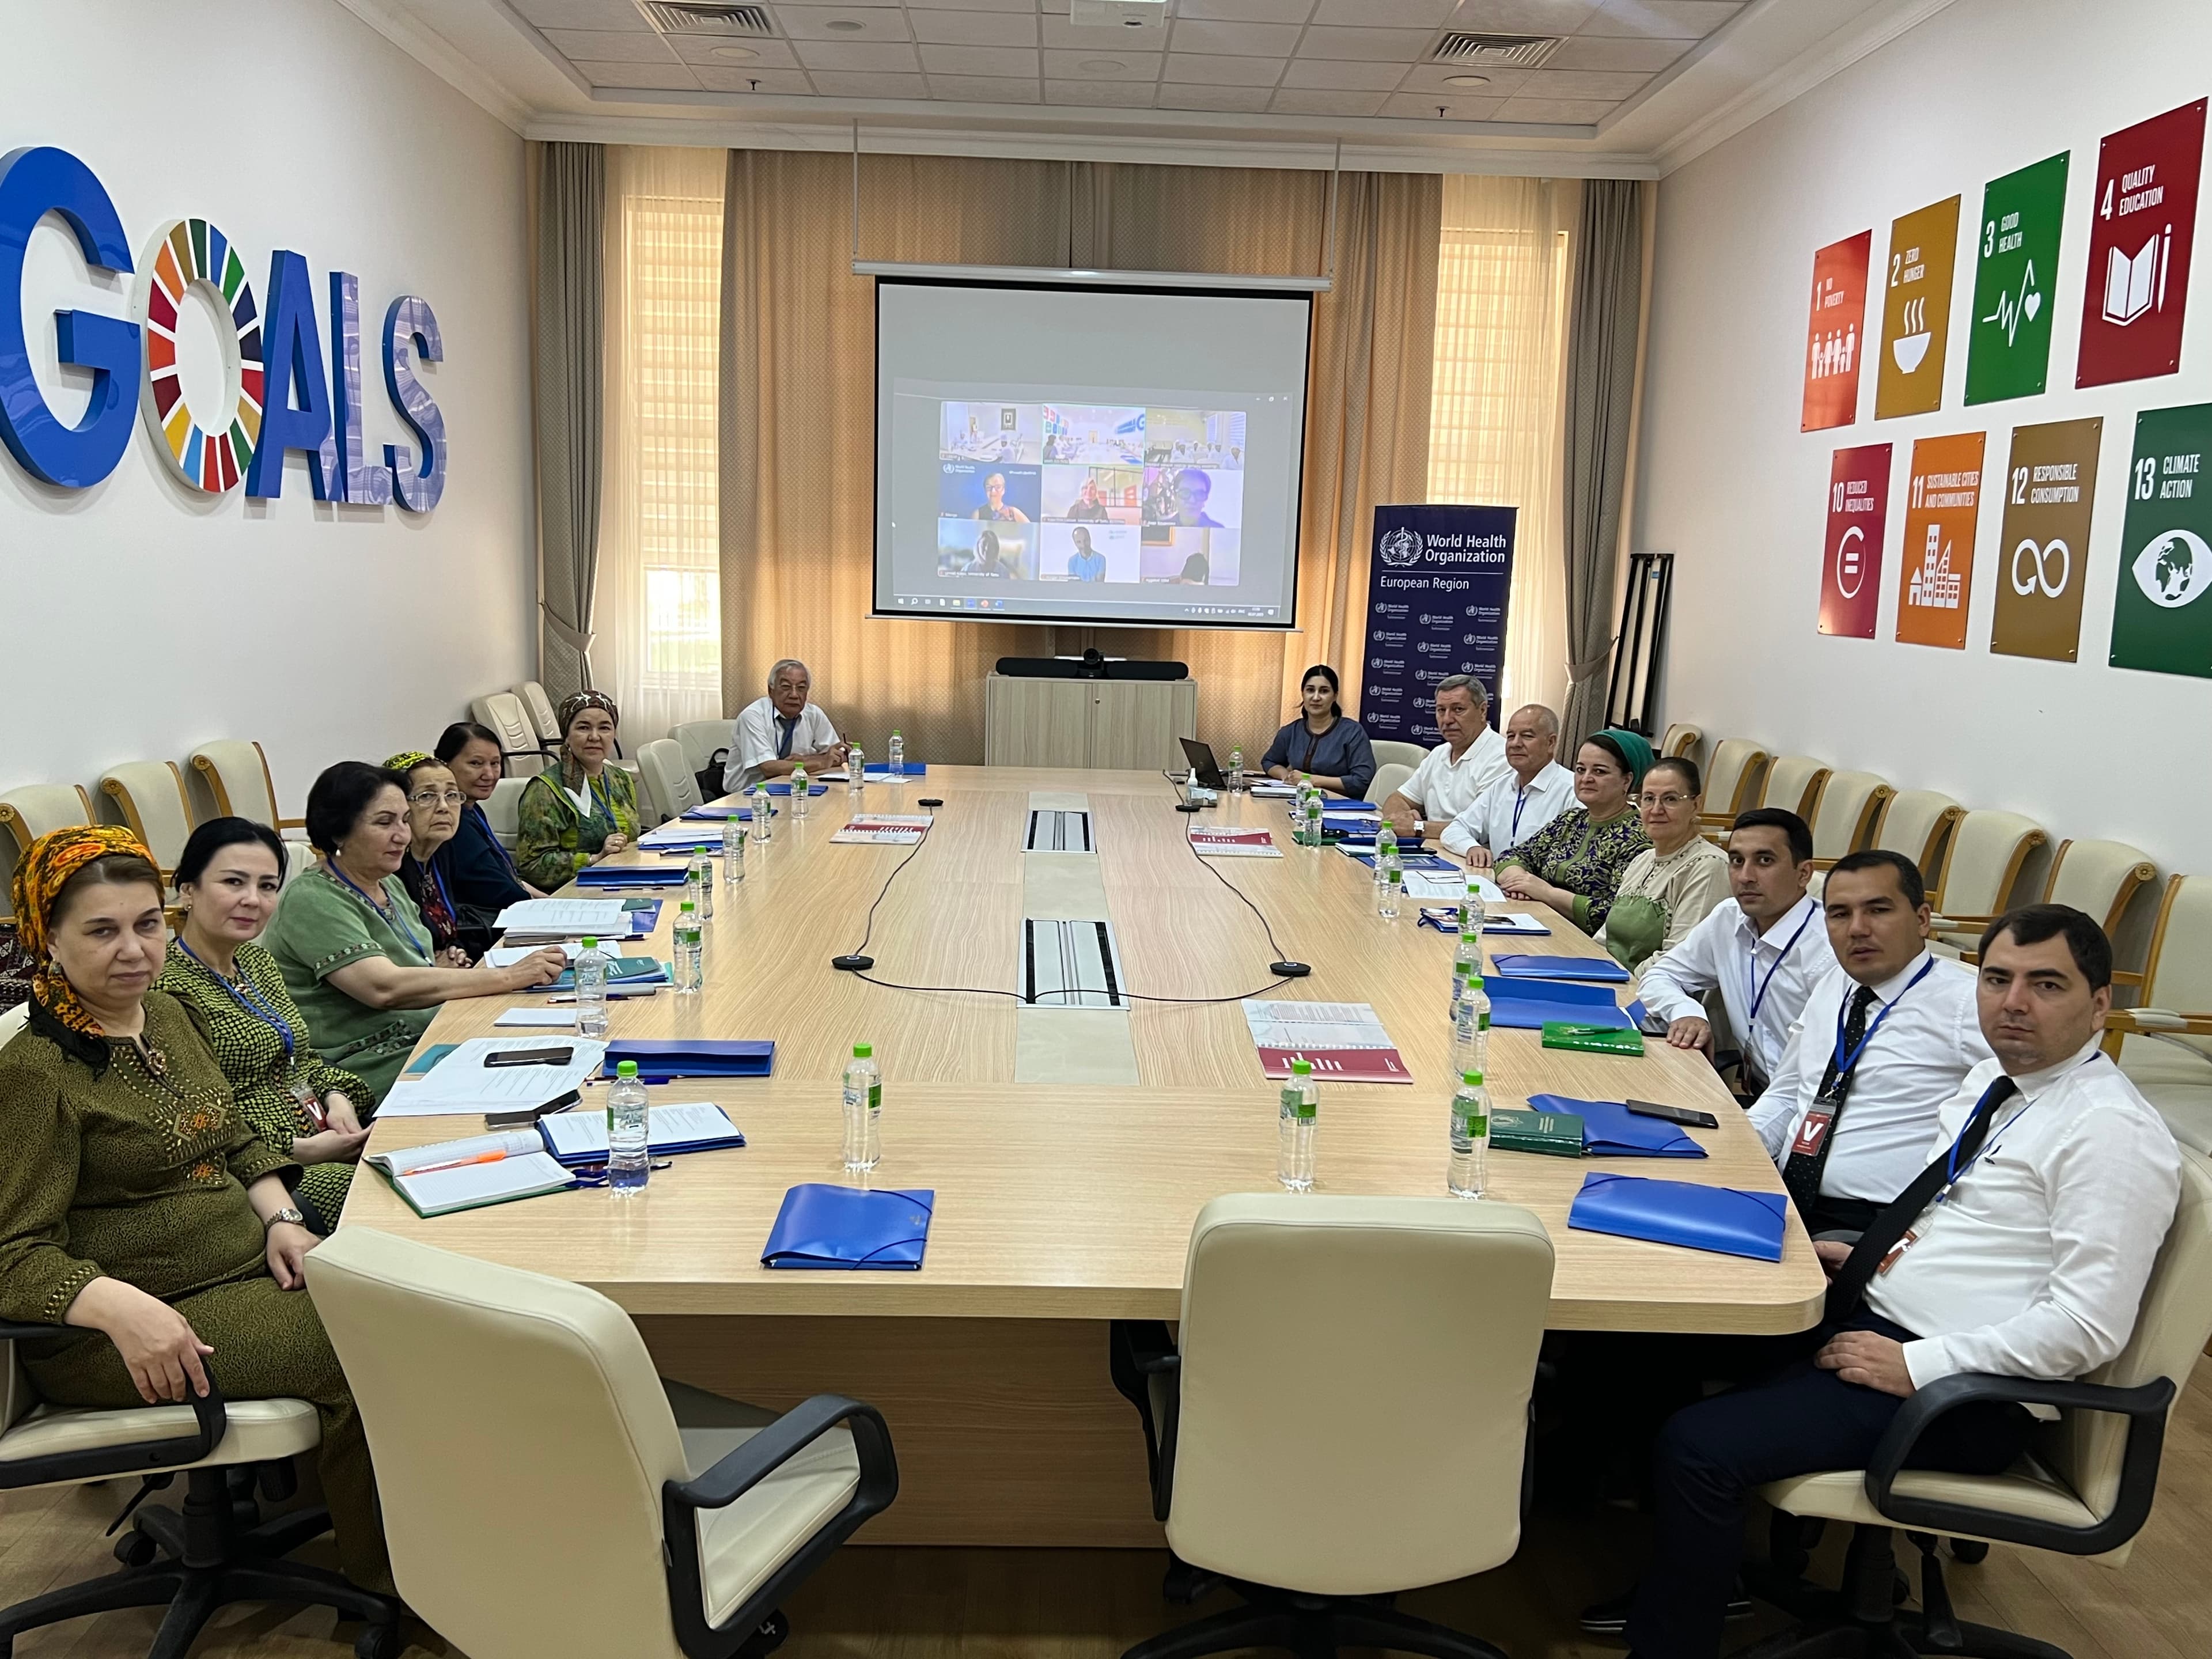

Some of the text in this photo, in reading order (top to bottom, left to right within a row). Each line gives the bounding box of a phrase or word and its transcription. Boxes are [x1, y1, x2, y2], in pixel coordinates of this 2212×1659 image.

[2122, 164, 2156, 194] QUALITY
[2100, 179, 2115, 220] 4
[2119, 185, 2164, 216] EDUCATION
[2001, 211, 2019, 232] GOOD
[1984, 221, 1995, 258] 3
[1998, 232, 2022, 253] HEALTH
[1891, 253, 1900, 287] 2
[1816, 281, 1821, 311] 1
[0, 146, 447, 512] GOALS
[2033, 463, 2078, 482] RESPONSIBLE
[2163, 454, 2200, 475] CLIMATE
[1927, 471, 1979, 488] SUSTAINABLE CITIES
[2011, 467, 2028, 504] 12
[2134, 457, 2156, 500] 13
[2160, 479, 2192, 499] ACTION
[1832, 482, 1844, 513] 10
[1912, 476, 1925, 509] 11
[1925, 491, 1975, 507] AND COMMUNITIES
[2031, 486, 2080, 503] CONSUMPTION
[1427, 534, 1506, 548] World Health
[1425, 549, 1505, 565] Organization
[1380, 576, 1469, 592] European Region
[307, 1101, 323, 1120] V
[1804, 1120, 1824, 1141] V
